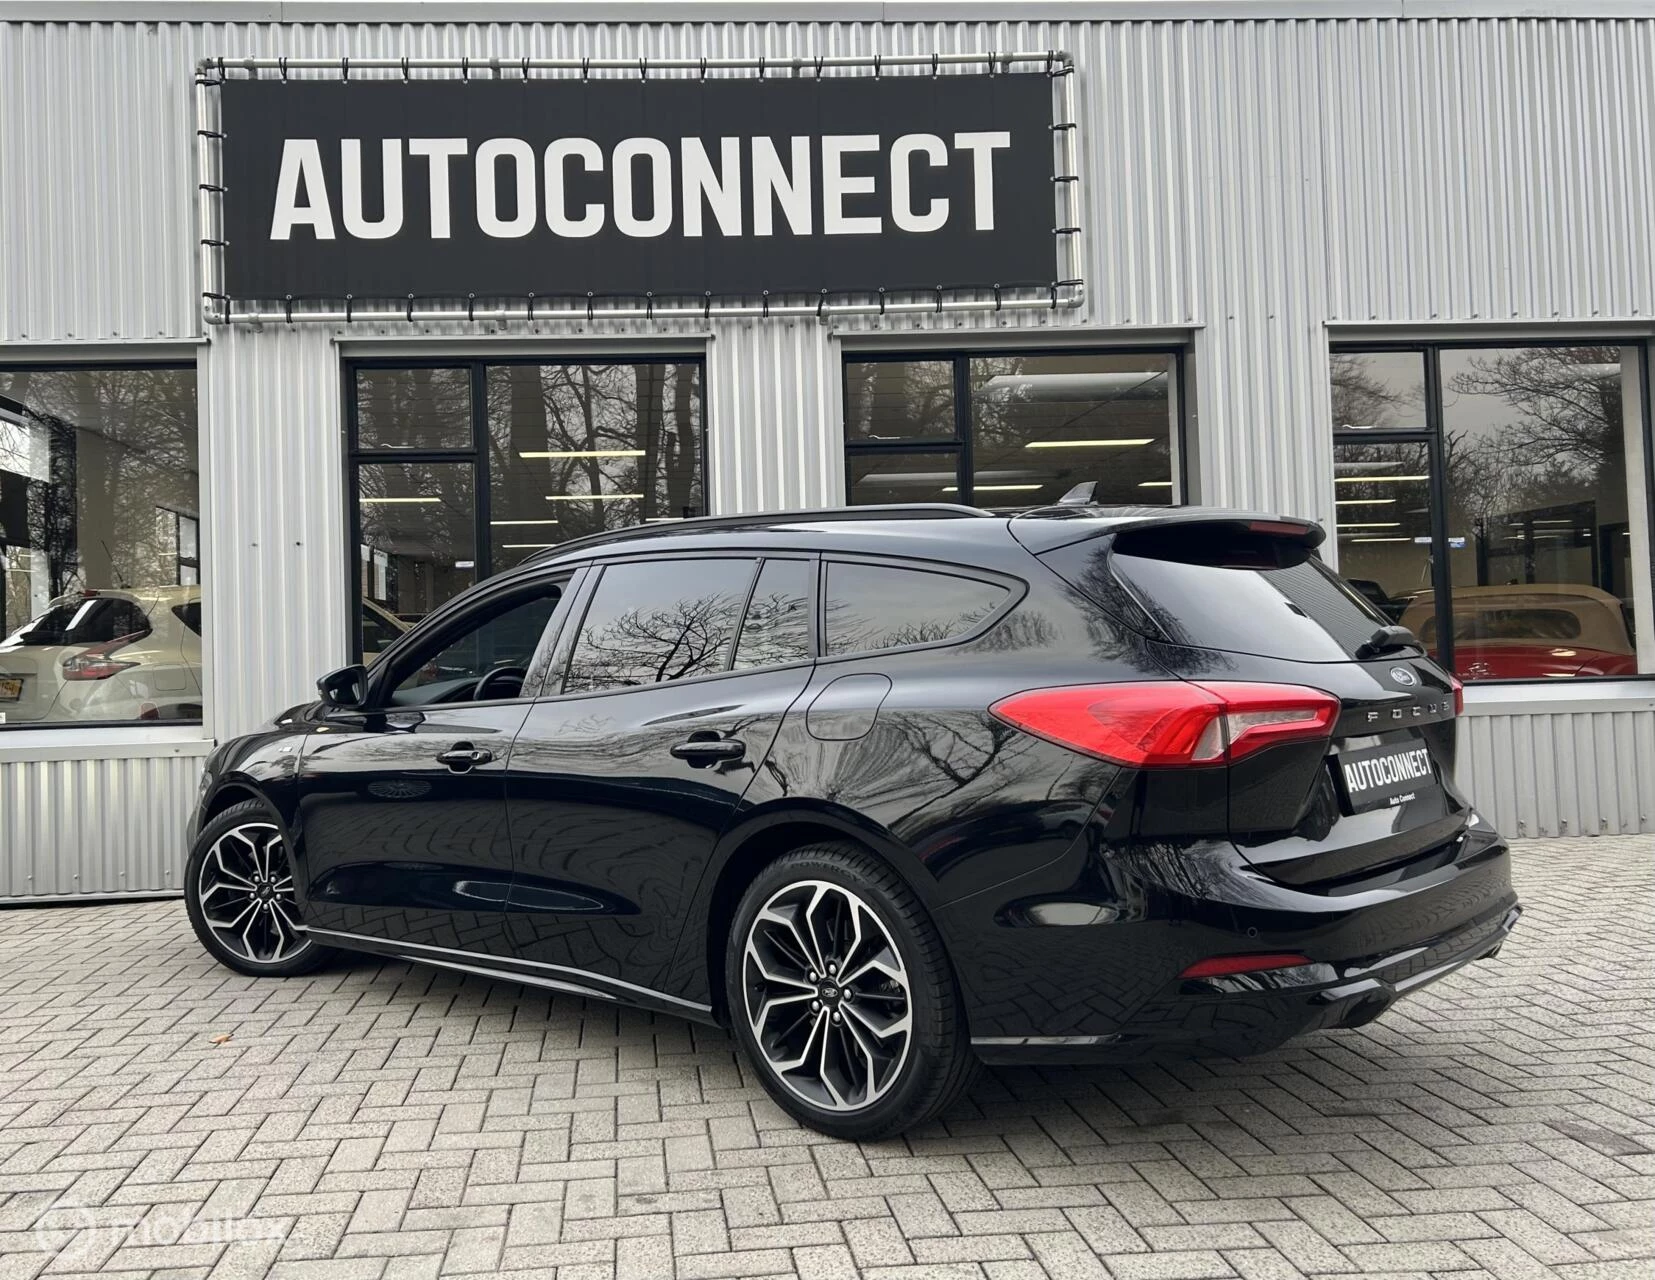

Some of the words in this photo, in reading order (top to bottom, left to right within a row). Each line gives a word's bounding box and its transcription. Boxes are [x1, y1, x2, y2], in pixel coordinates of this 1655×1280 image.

[269, 130, 1012, 241] AUTOCONNECT
[1367, 701, 1450, 722] FOCUS
[1343, 748, 1432, 793] AUTOCONNECT
